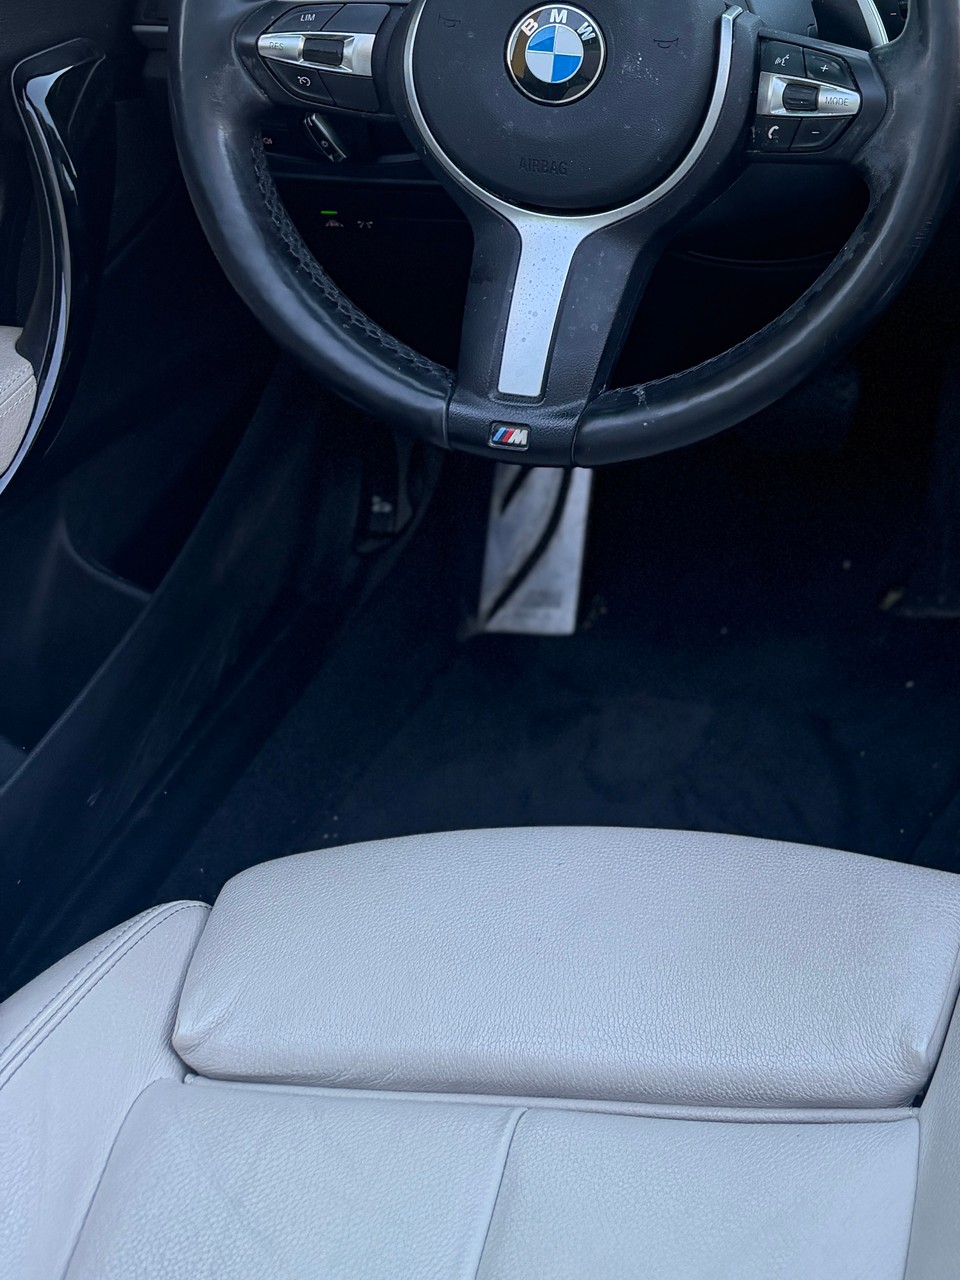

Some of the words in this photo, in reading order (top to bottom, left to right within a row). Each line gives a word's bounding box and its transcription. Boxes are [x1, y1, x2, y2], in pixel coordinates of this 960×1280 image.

[300, 14, 316, 22] LIM
[521, 9, 596, 41] BMW
[268, 41, 284, 50] RES
[824, 96, 849, 107] MODE
[519, 157, 570, 176] AIRBAG
